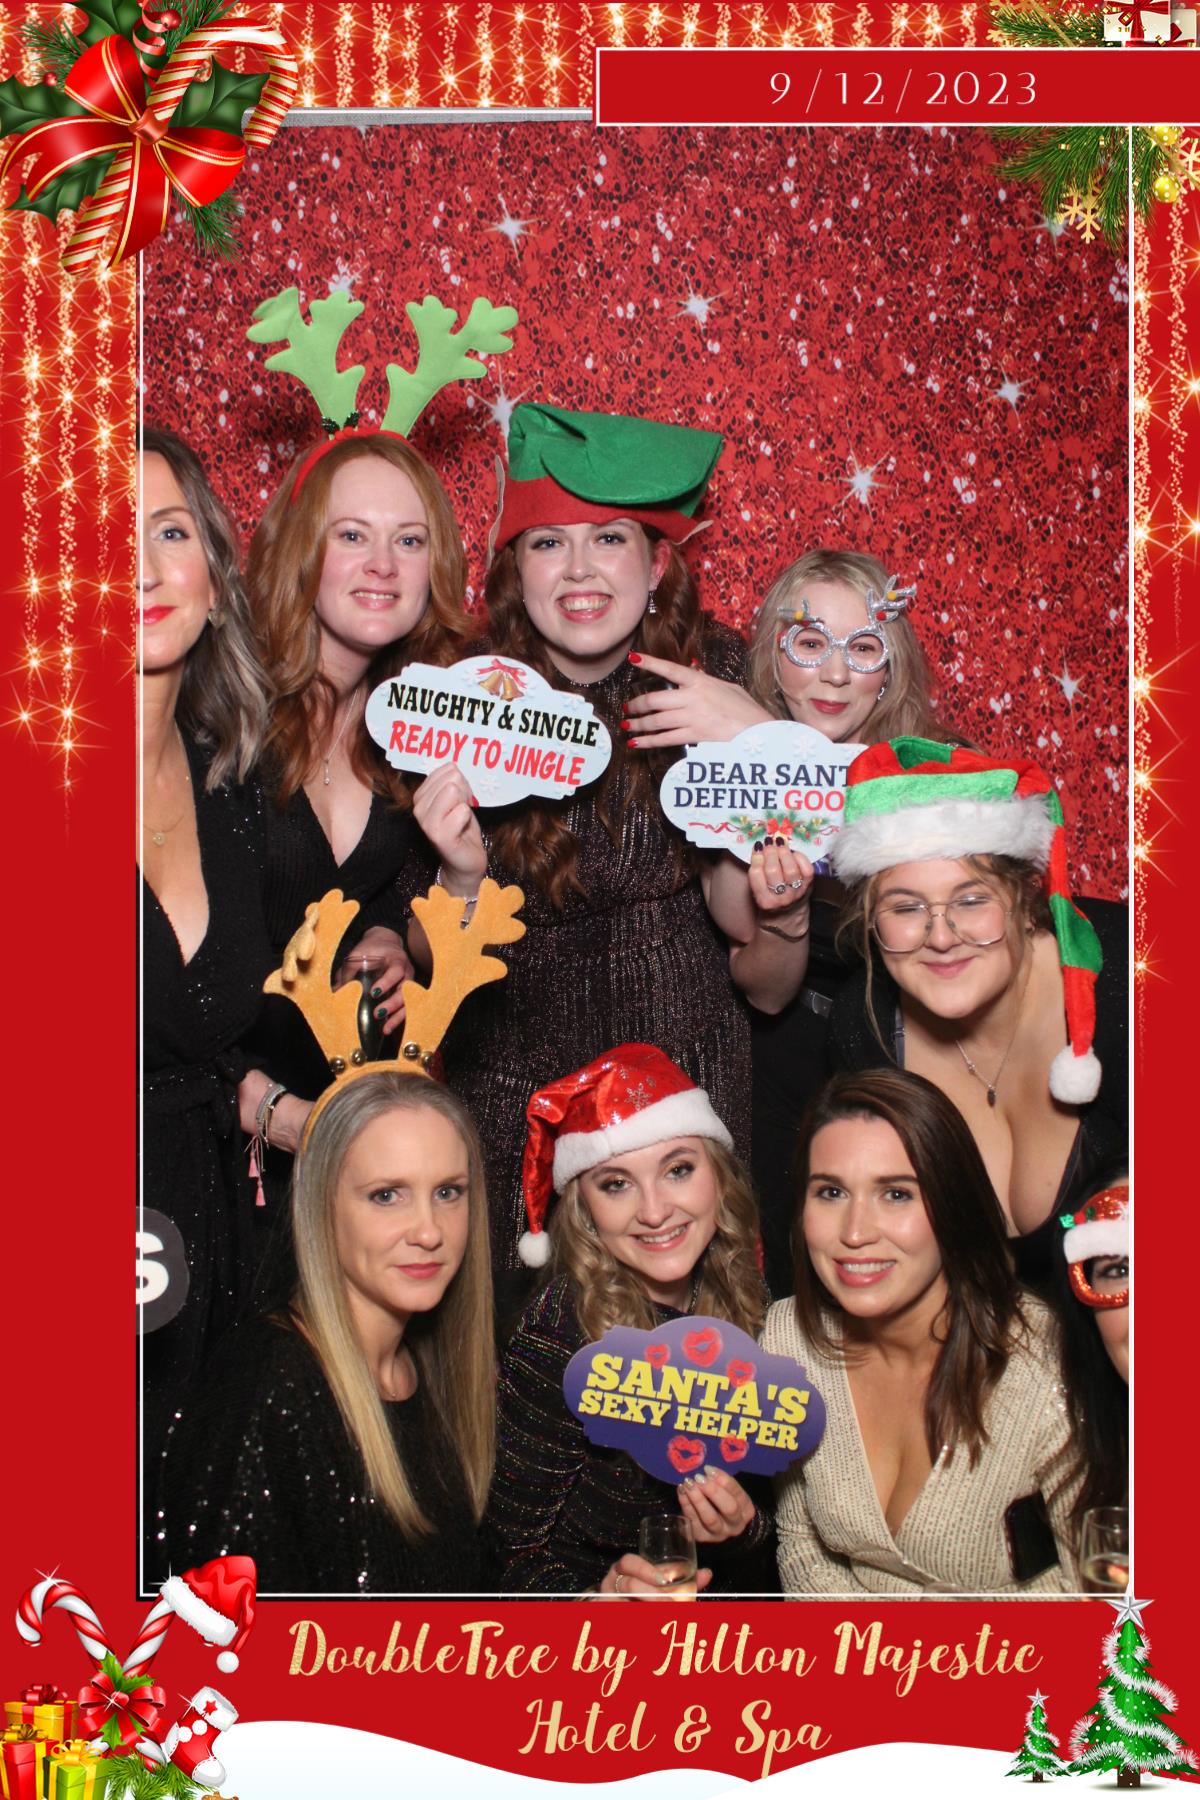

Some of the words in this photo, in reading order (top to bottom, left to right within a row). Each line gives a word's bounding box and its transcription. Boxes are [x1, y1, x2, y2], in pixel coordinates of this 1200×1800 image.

[387, 682, 495, 726] NAUGHTY
[497, 704, 515, 731] &
[518, 708, 600, 747] SINGLE
[389, 720, 469, 764] READY
[472, 737, 502, 769] TO
[504, 744, 586, 786] JINGLE
[686, 761, 768, 786] DEAR
[775, 763, 849, 788] SANT
[674, 786, 777, 810] DEFINE
[783, 789, 846, 812] GOO
[578, 1388, 671, 1427] SEXY
[674, 1405, 799, 1451] HELPER
[586, 1353, 810, 1425] SANTA'S
